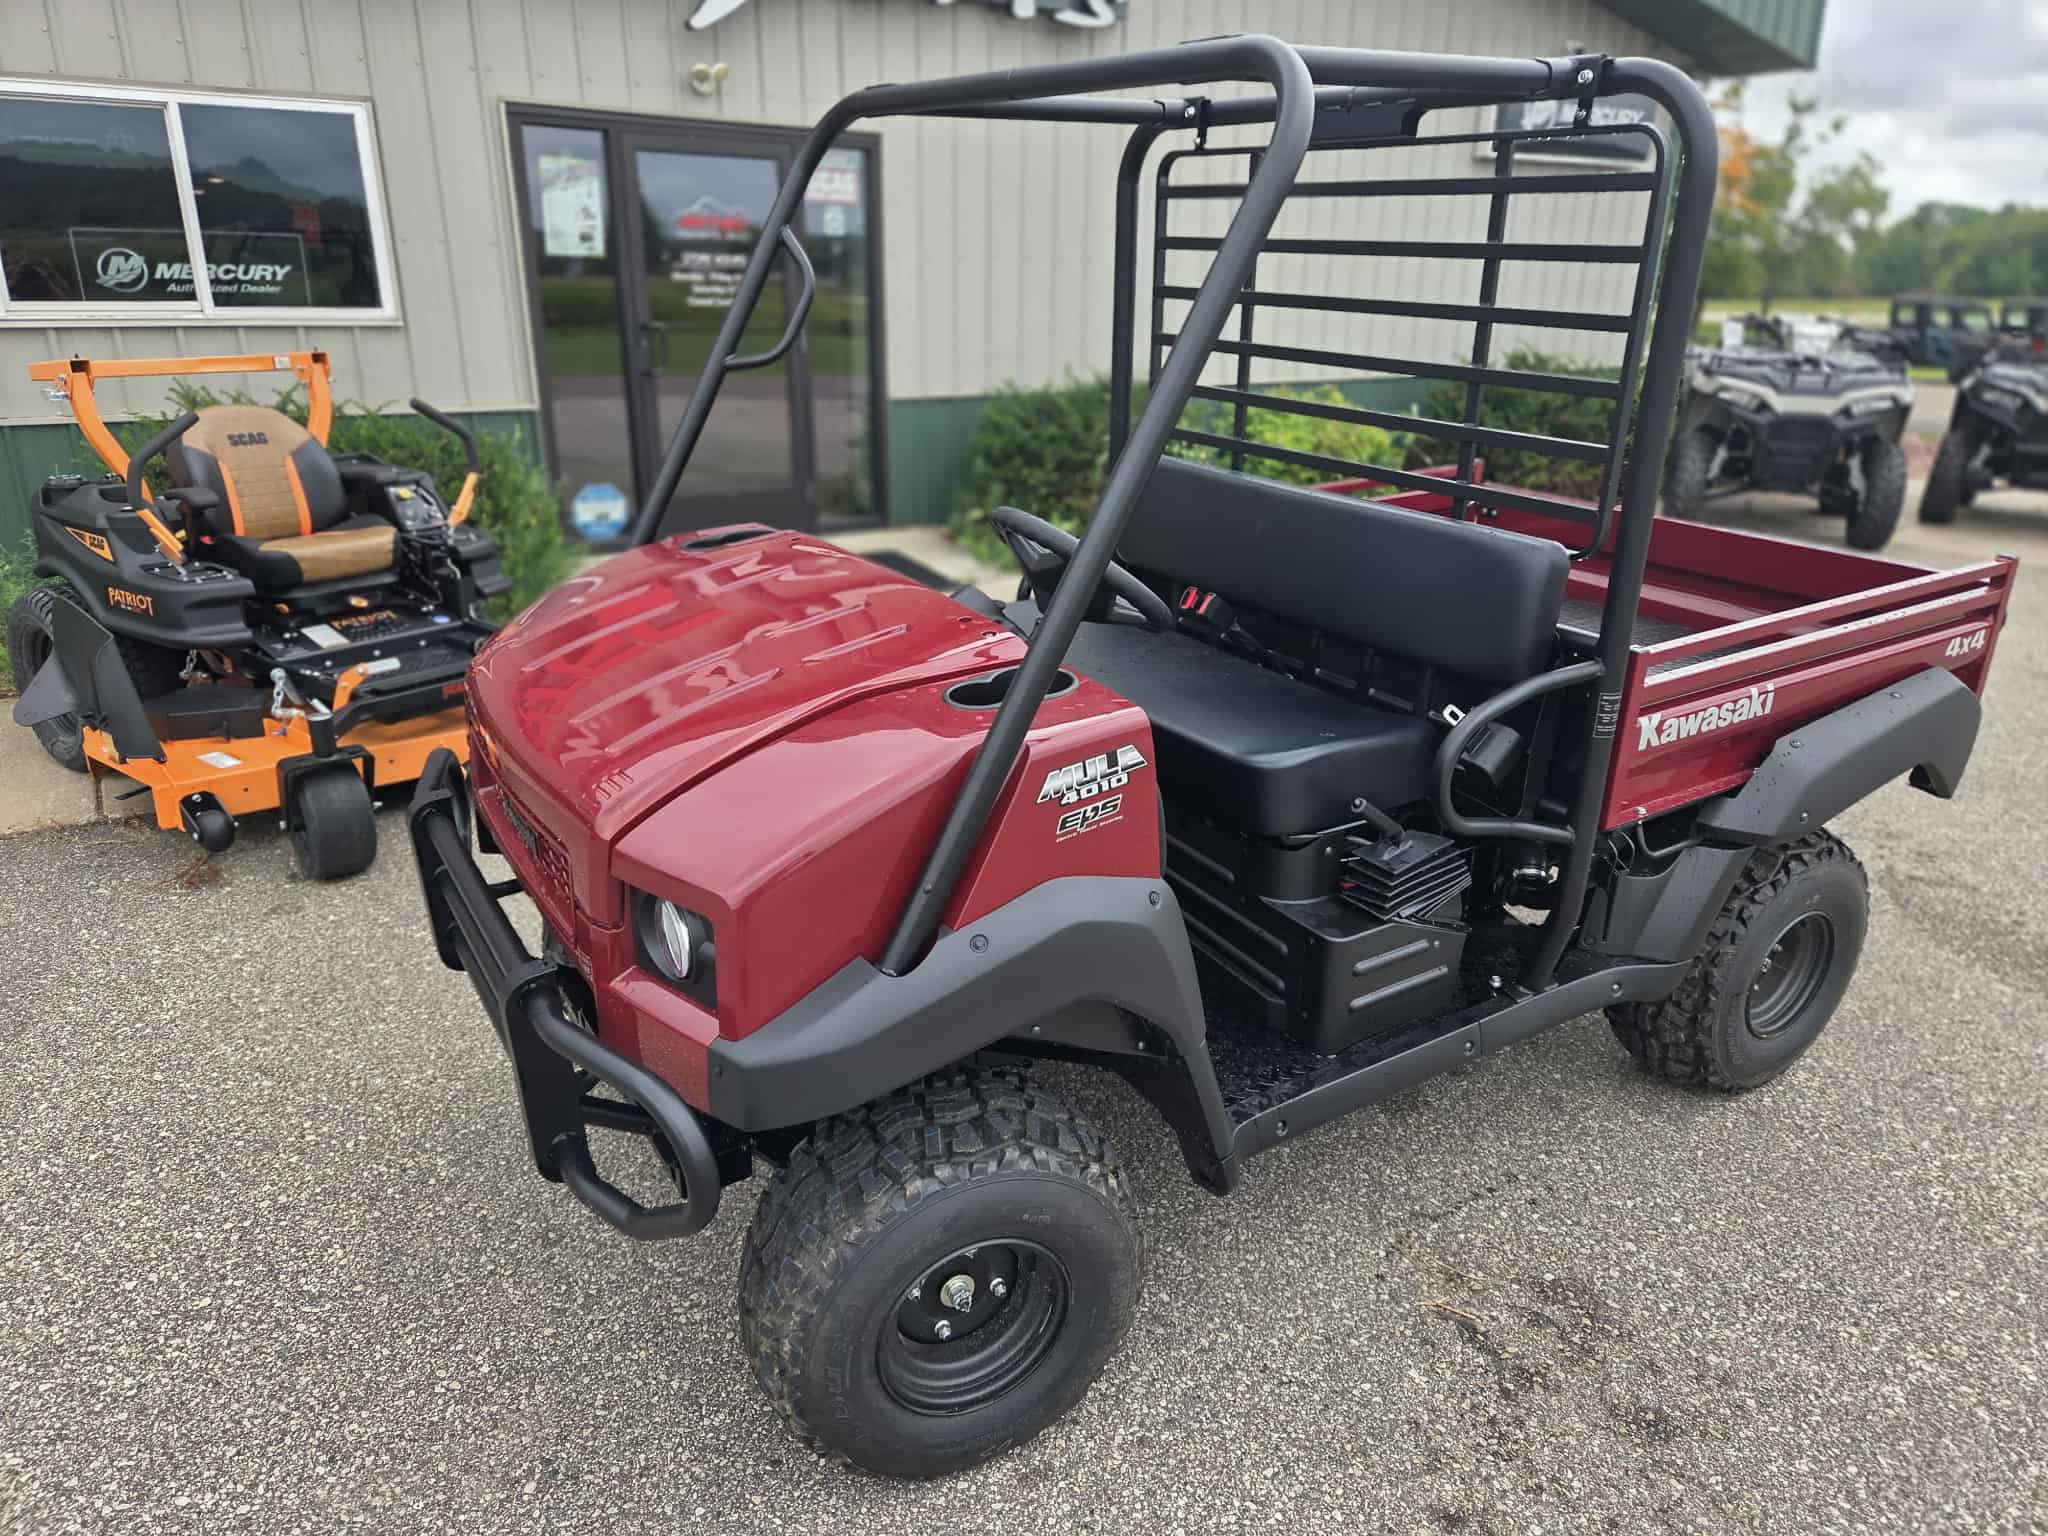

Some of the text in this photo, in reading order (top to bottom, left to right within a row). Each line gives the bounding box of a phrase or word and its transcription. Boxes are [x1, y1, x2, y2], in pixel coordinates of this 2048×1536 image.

[241, 284, 282, 293] Dealer
[226, 432, 269, 447] SCAG
[107, 586, 153, 616] PATRIOT
[1945, 629, 1986, 657] 4x4
[1638, 682, 1775, 751] Kawasaki
[1036, 744, 1148, 804] MULE
[1060, 772, 1129, 805] 4010
[1055, 793, 1123, 834] EPS
